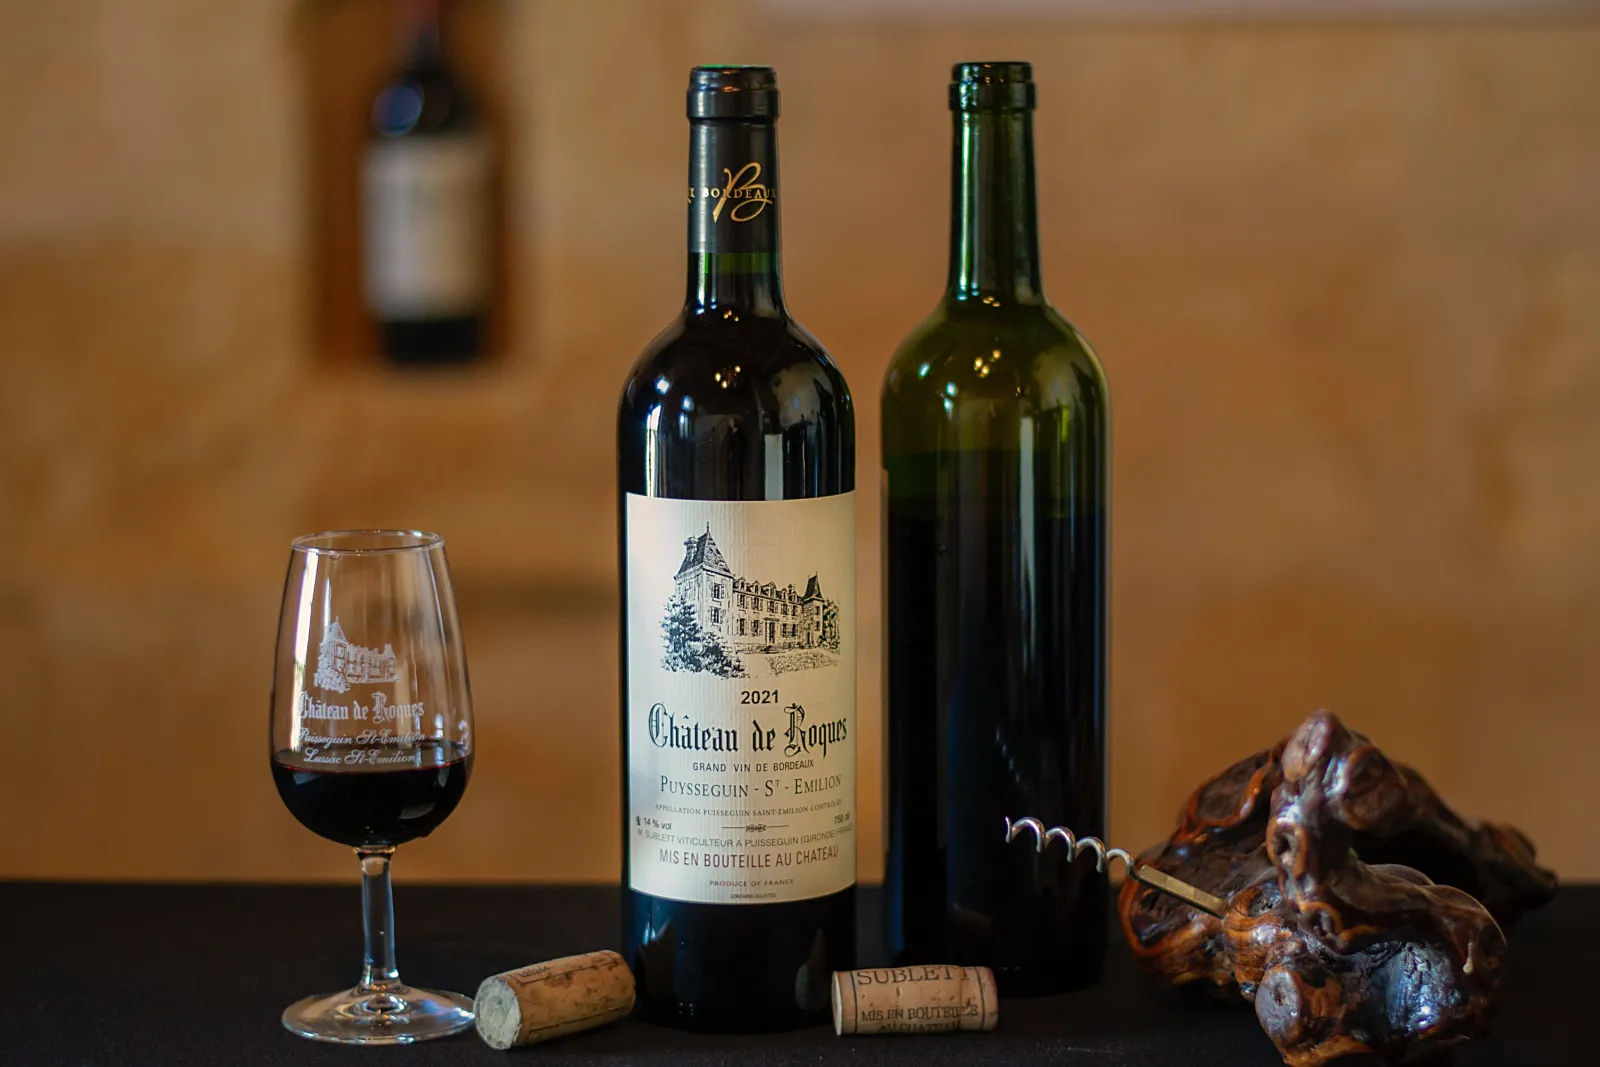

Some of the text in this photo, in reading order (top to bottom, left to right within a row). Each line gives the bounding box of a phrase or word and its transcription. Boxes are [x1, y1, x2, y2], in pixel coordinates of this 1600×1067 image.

[700, 187, 776, 199] BORDEAUX
[741, 689, 779, 704] 2021
[353, 699, 368, 720] de
[372, 690, 425, 726] Roques
[648, 701, 847, 758] Château de Roques
[298, 727, 426, 749] Puisseguin St-Emilion
[303, 747, 416, 765] Lussac St-Emilion
[692, 759, 815, 772] GRAND VIN DE BORDEAUX
[660, 774, 749, 798] PUYSSEGUIN
[794, 773, 842, 795] EMILION
[655, 803, 701, 815] APPELLATION
[703, 808, 750, 817] PUISSEGUIN
[643, 816, 672, 831] 14 % vol
[834, 813, 844, 825] 750
[645, 830, 675, 844] SUBLETT
[677, 836, 733, 848] VITICULTEUR
[744, 836, 799, 848] PUISSEGUIN
[659, 844, 839, 868] MIS EN BOUTEILLE AU CHATEAU
[764, 878, 794, 886] FRANCE
[857, 965, 969, 986] SUBLETT
[861, 1009, 884, 1022] MIS
[887, 1008, 903, 1020] EN
